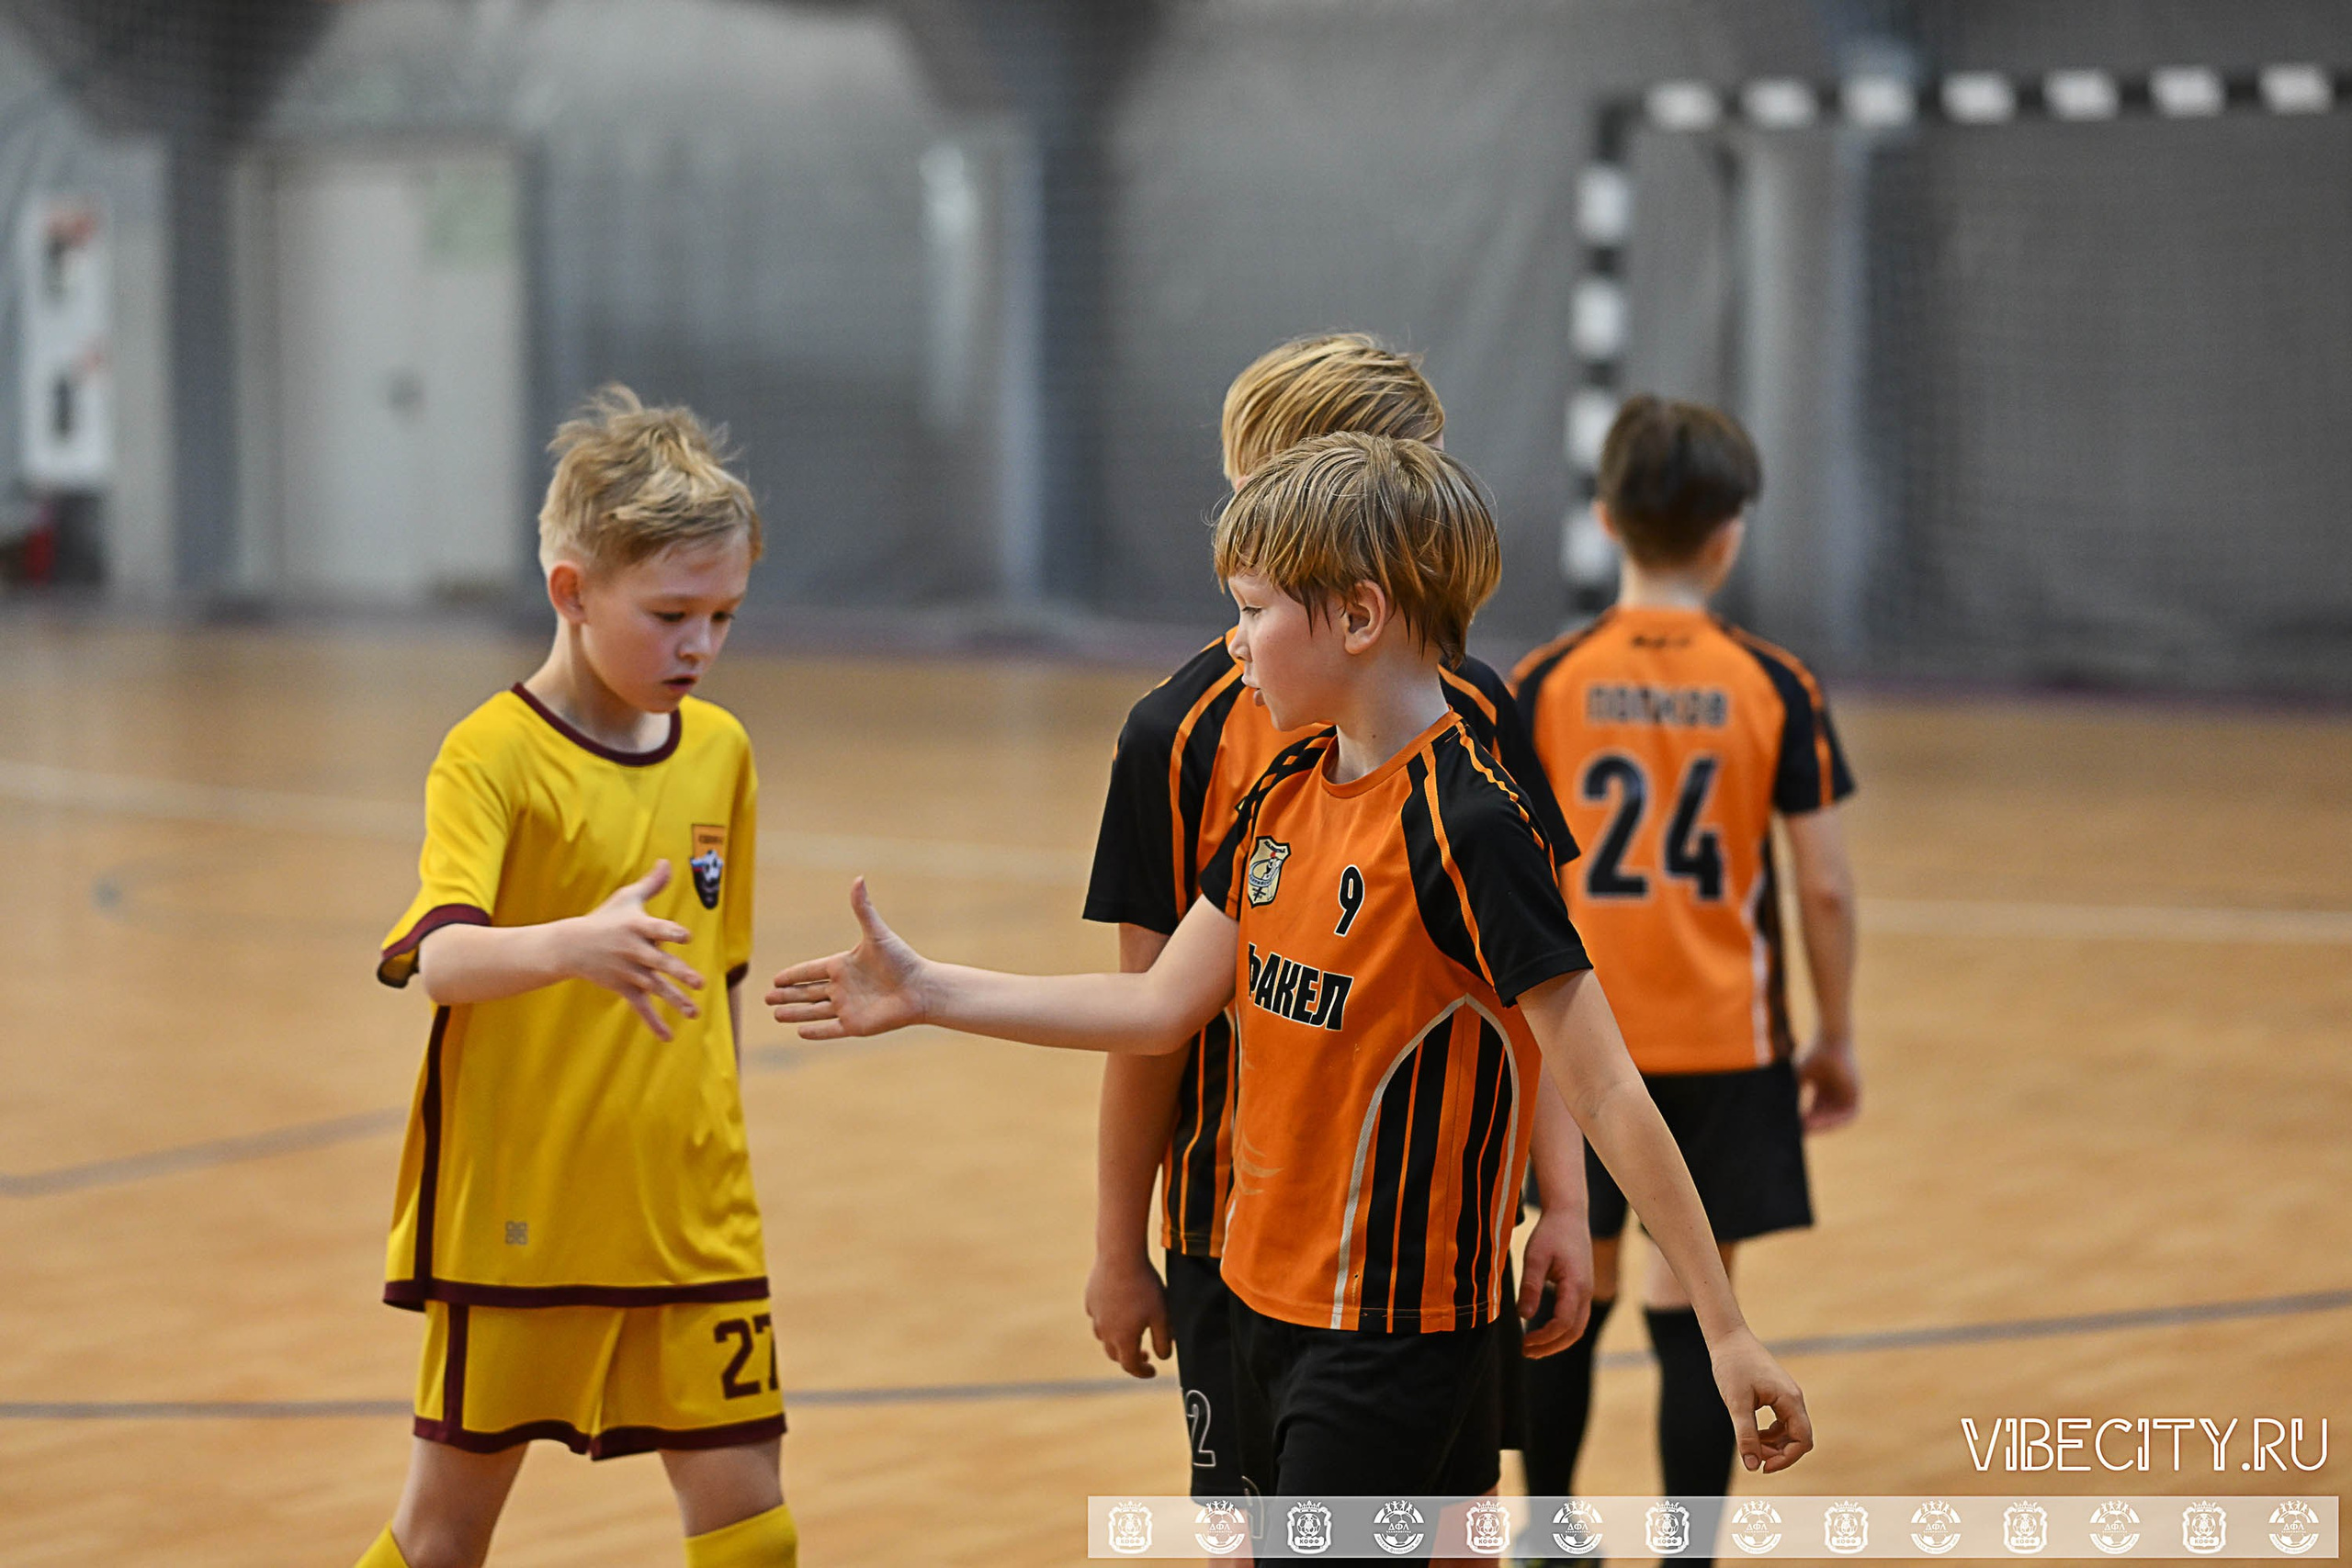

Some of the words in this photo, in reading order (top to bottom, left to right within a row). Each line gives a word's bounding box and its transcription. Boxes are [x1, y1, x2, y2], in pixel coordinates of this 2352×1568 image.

[1582, 753, 1724, 900] 24
[1334, 864, 1365, 937] 9
[713, 1313, 779, 1400] 27
[1185, 1390, 1216, 1467] 2
